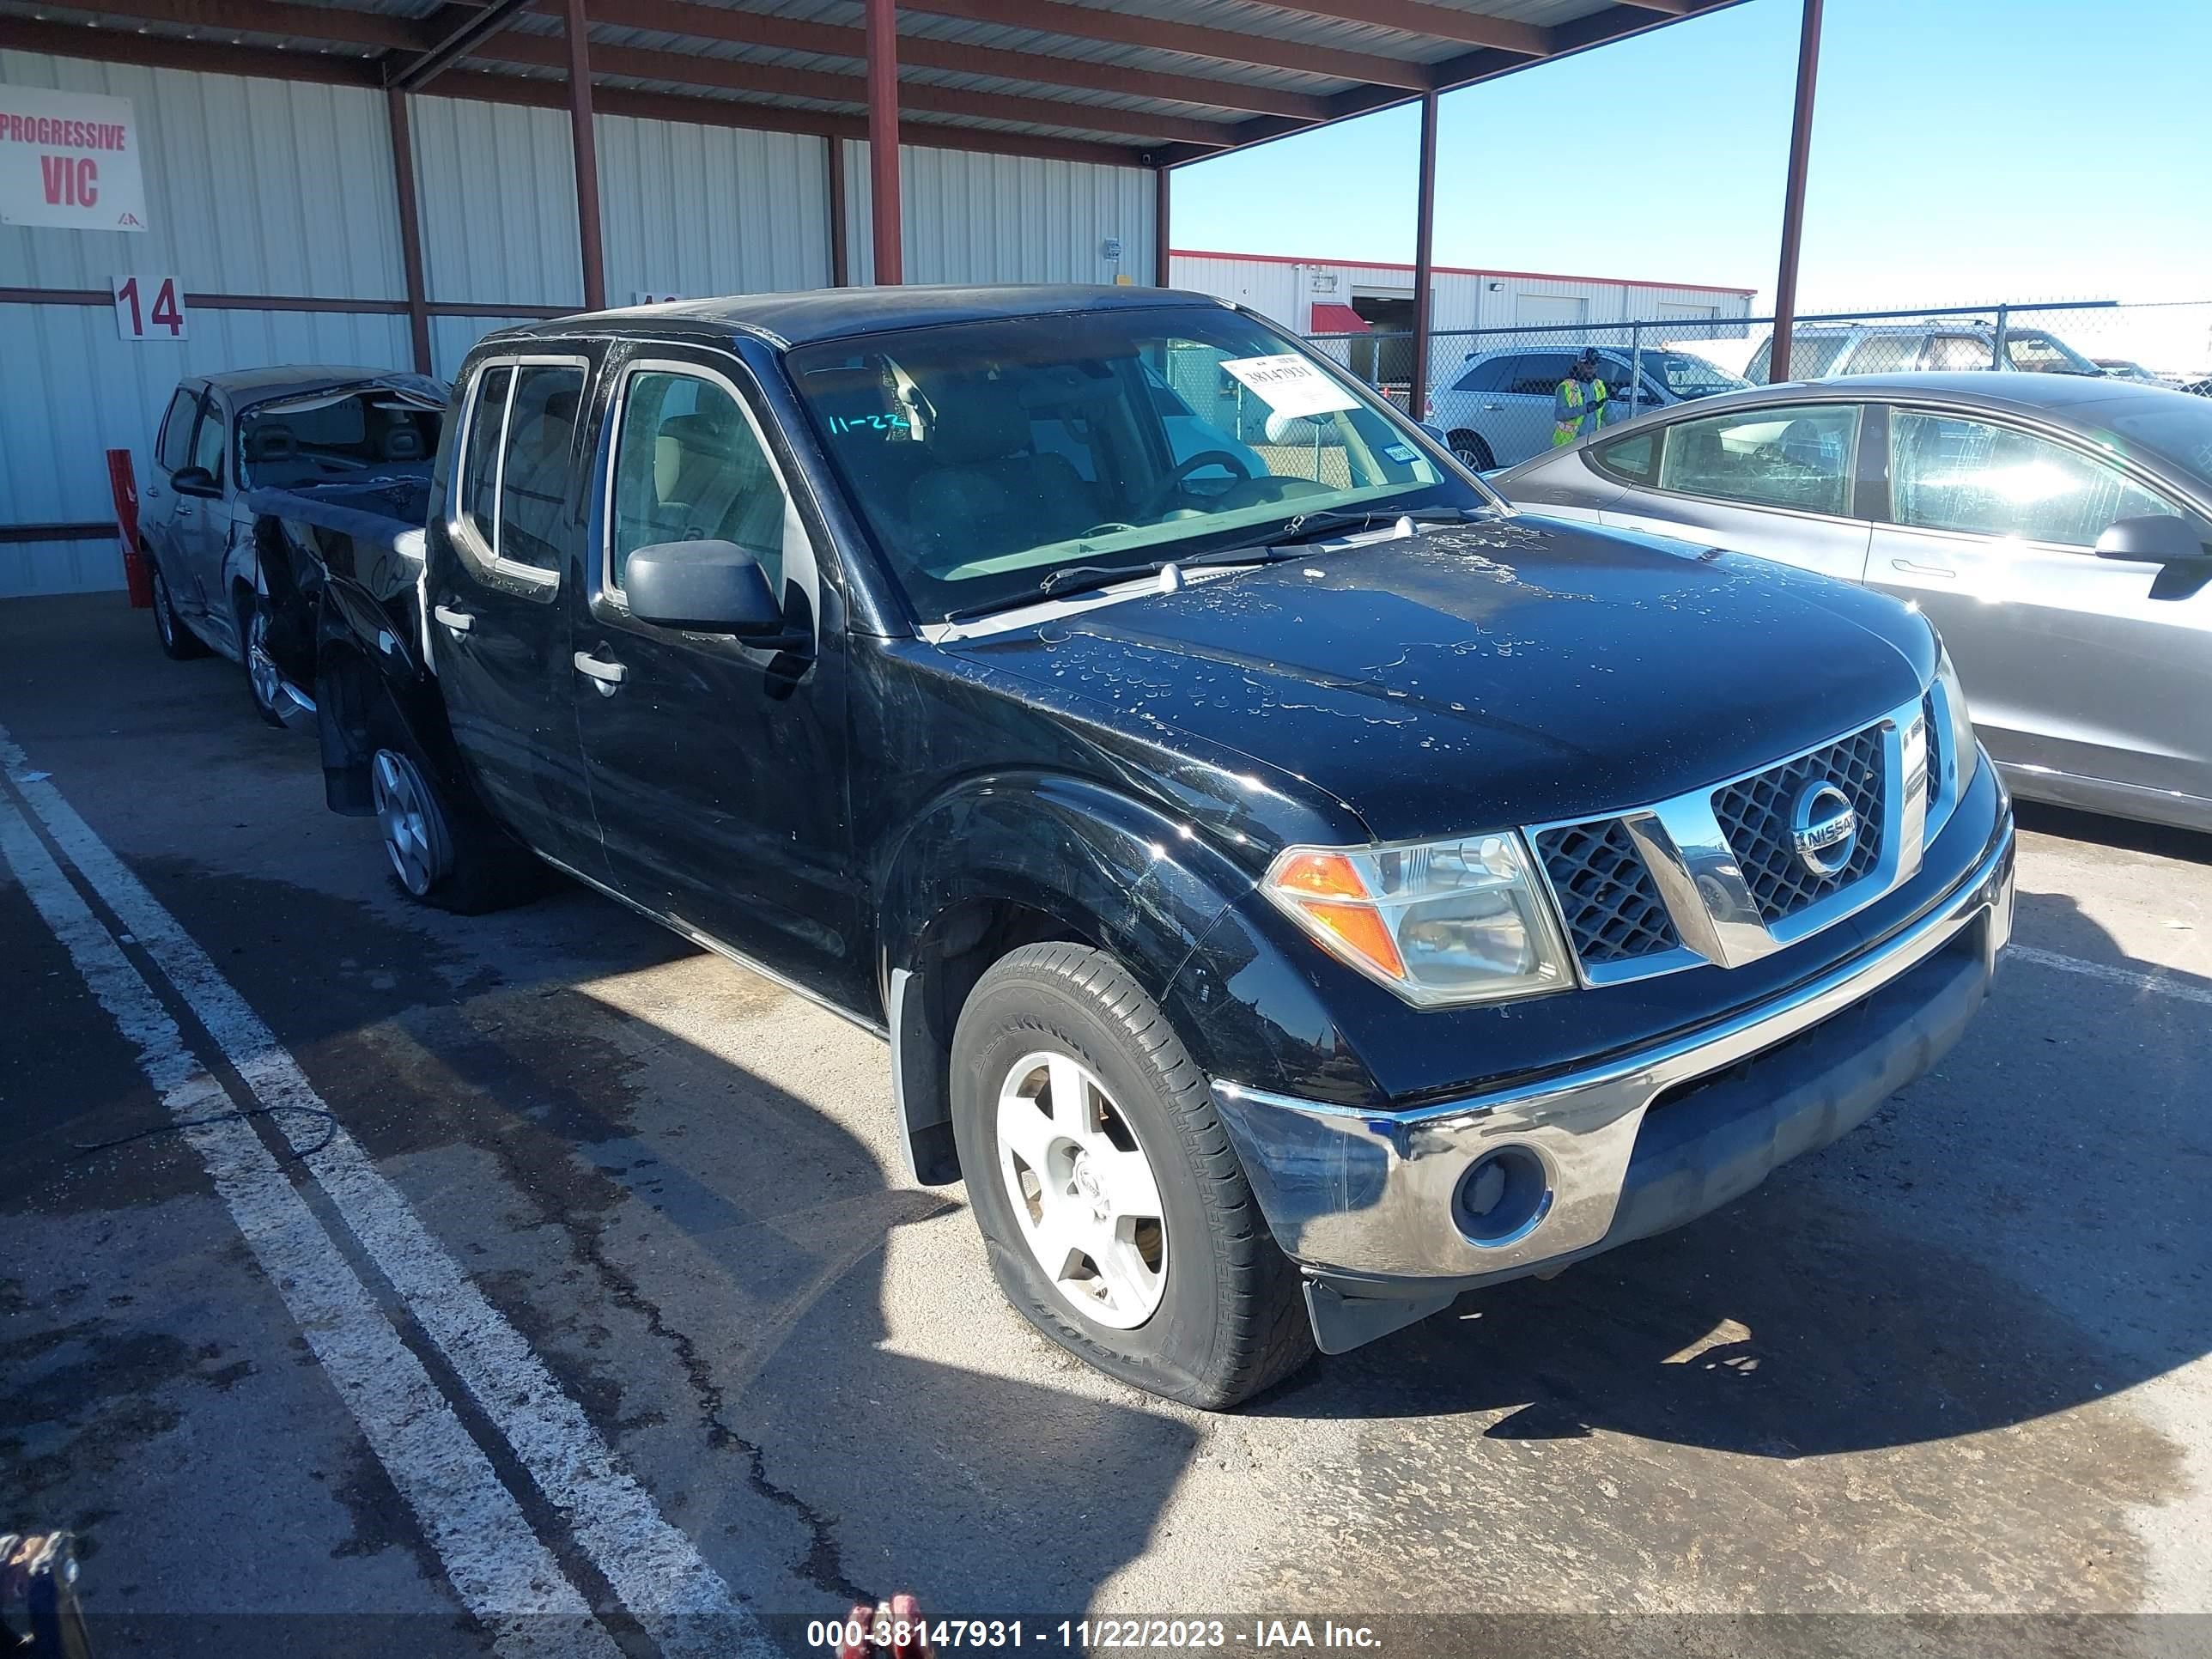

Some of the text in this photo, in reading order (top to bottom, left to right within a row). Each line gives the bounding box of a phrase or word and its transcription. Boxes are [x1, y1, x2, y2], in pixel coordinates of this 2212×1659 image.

[0, 113, 125, 152] PROGRESSIVE
[40, 155, 99, 208] VIC
[118, 277, 183, 336] 14
[1245, 365, 1313, 385] 38147931
[830, 415, 910, 434] 11-22
[1808, 812, 1856, 848] NISSAN
